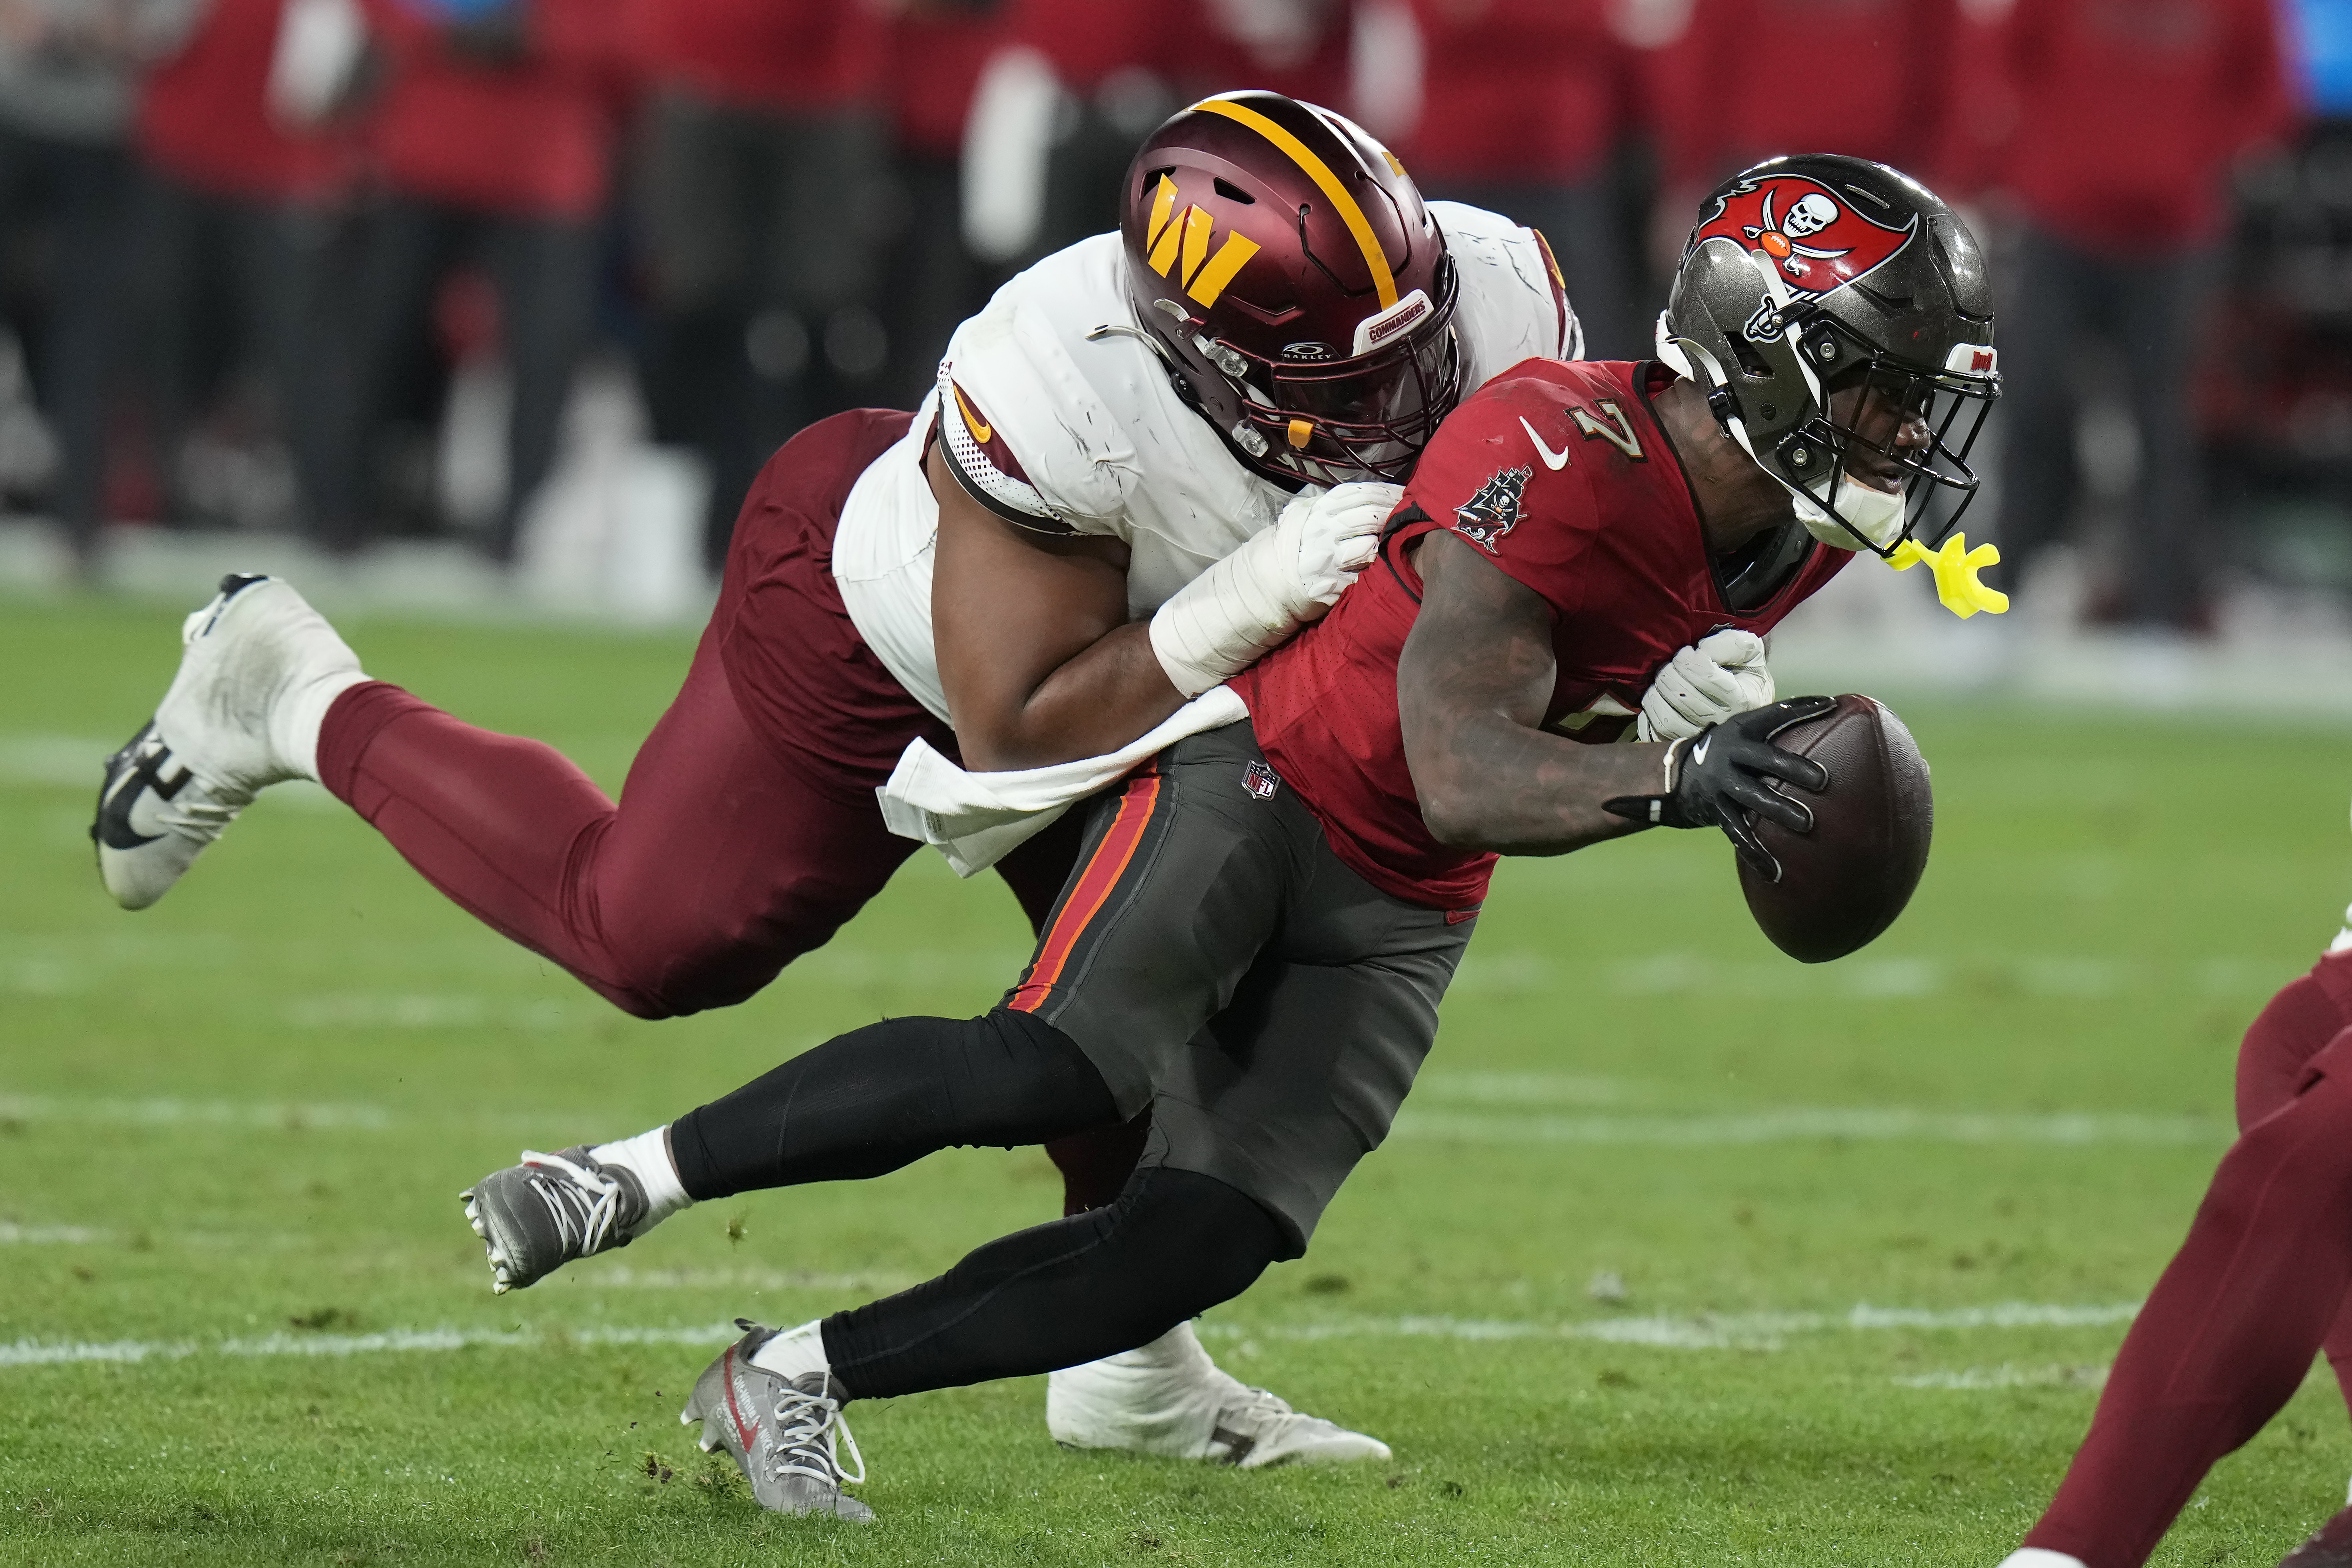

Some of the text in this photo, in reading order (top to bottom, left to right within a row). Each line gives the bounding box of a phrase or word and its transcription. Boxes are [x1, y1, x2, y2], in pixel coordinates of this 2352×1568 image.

[1147, 173, 1261, 309] W
[1369, 300, 1426, 341] COMMANDERS
[1563, 398, 1648, 463] 7
[1248, 773, 1270, 795] NFL
[758, 1427, 774, 1453] NIKE
